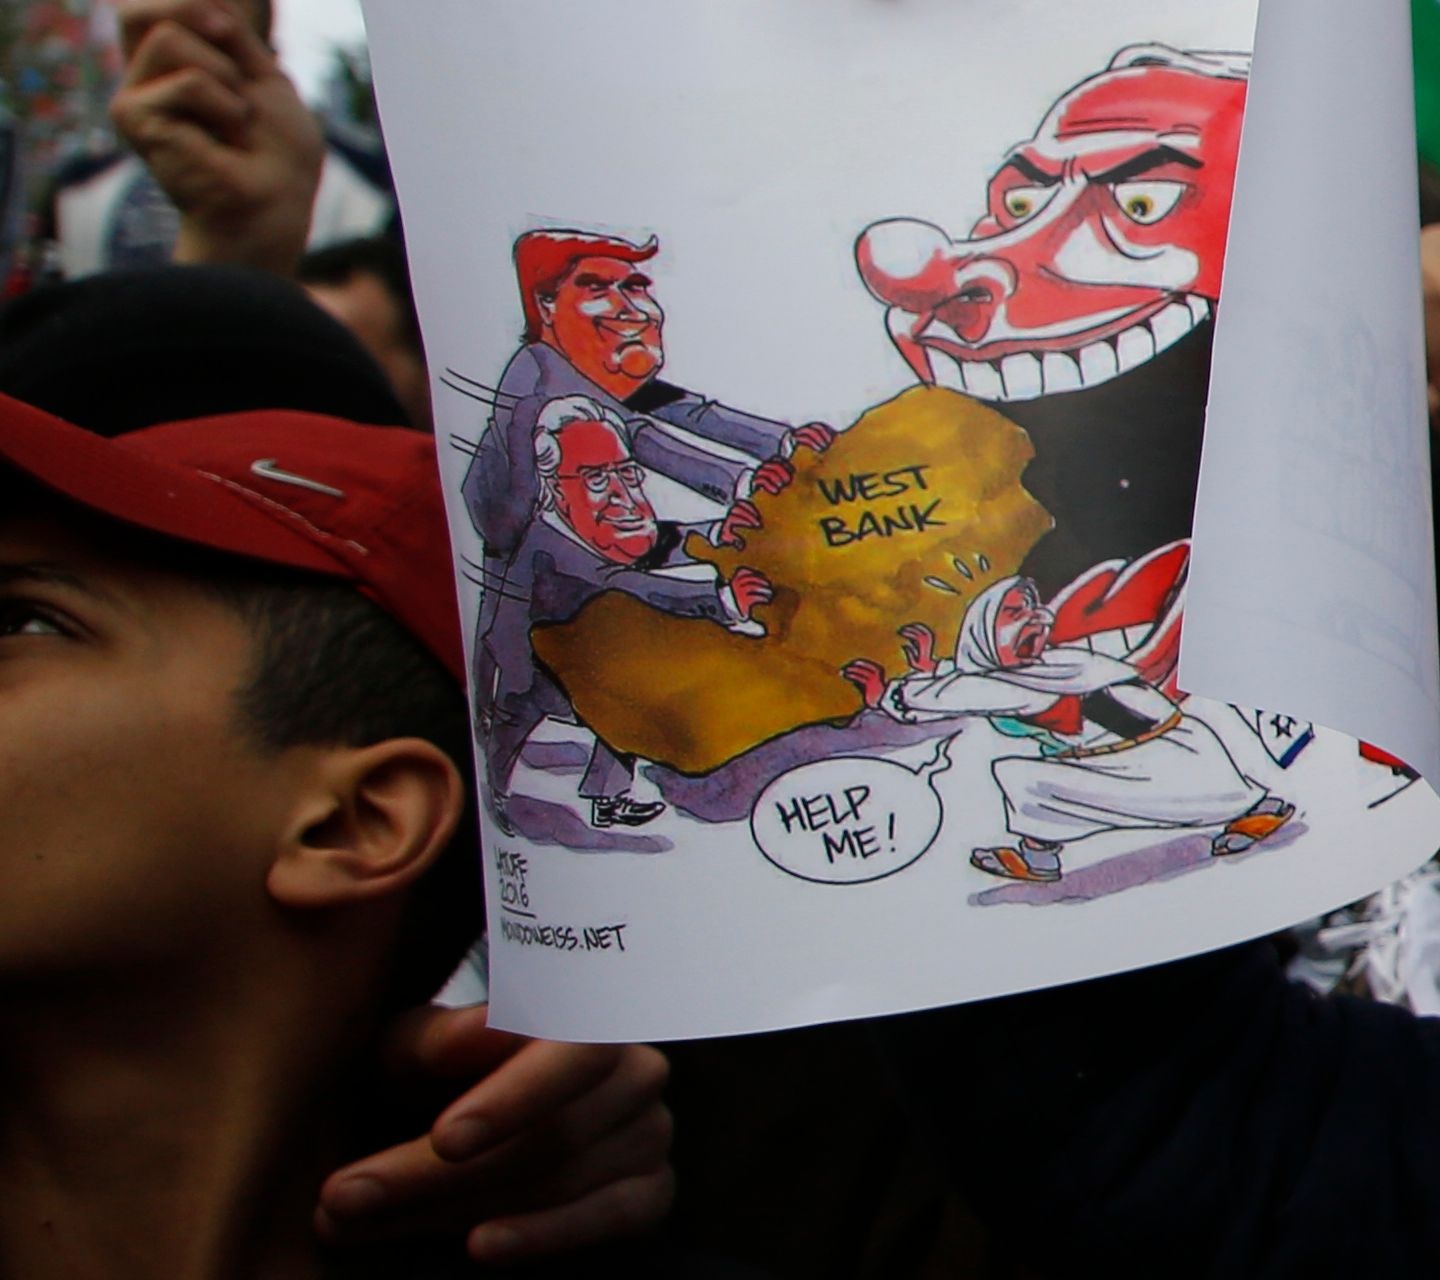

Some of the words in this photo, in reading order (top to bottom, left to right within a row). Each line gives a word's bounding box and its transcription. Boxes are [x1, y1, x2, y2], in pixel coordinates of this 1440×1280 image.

[817, 464, 931, 505] WEST
[818, 498, 947, 547] BANK
[775, 784, 871, 834] HELP
